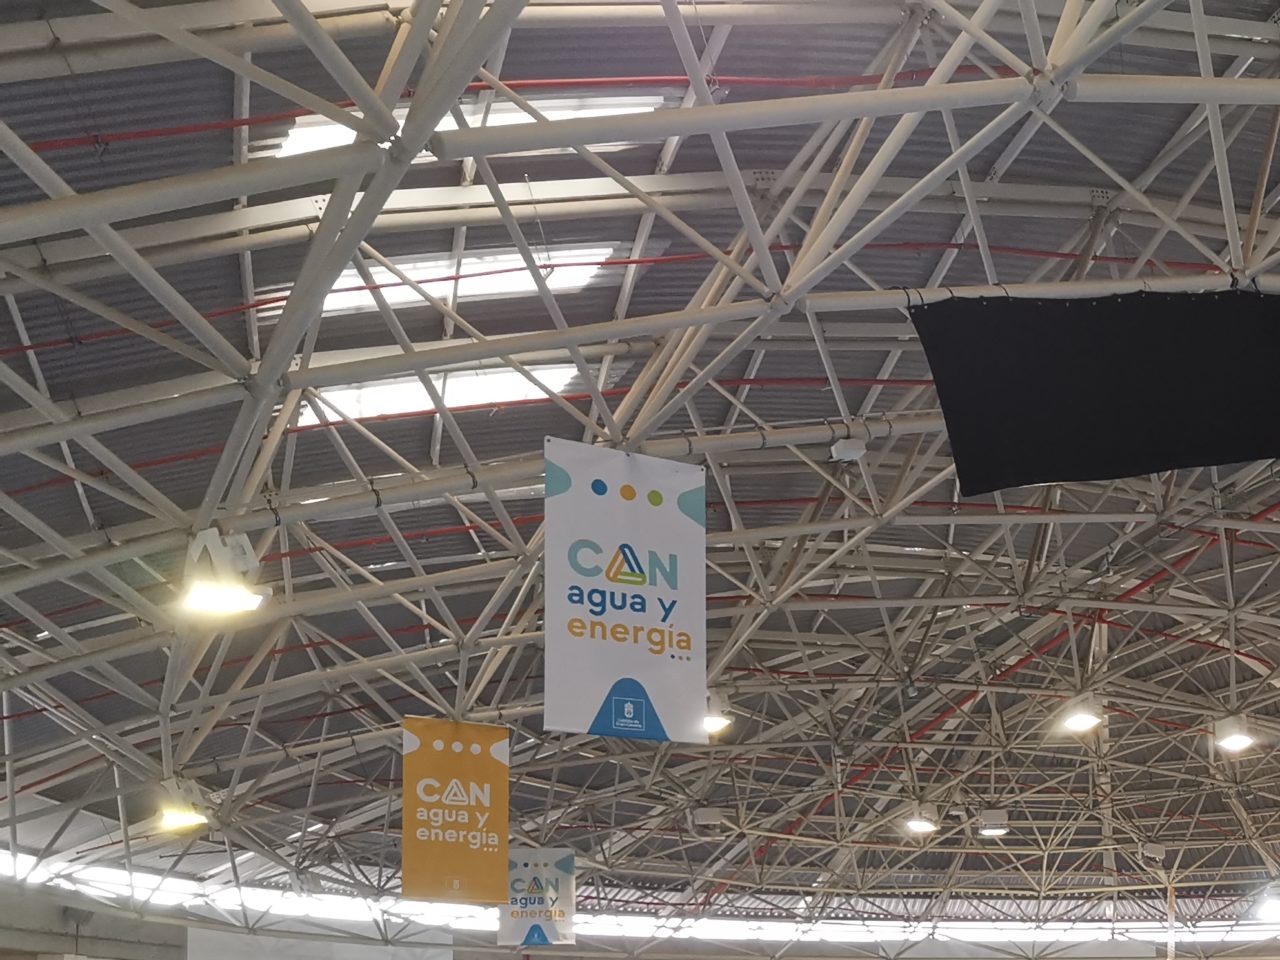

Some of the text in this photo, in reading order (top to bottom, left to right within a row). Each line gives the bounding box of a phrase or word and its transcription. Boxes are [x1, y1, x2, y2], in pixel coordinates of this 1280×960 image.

[567, 539, 678, 590] CAN
[567, 585, 677, 622] agua y
[567, 618, 692, 655] energía
[416, 778, 490, 807] CAN
[416, 807, 489, 828] agua y
[416, 827, 499, 849] energía
[510, 876, 560, 894] CAN
[510, 896, 559, 908] agua y
[510, 908, 566, 921] energía
